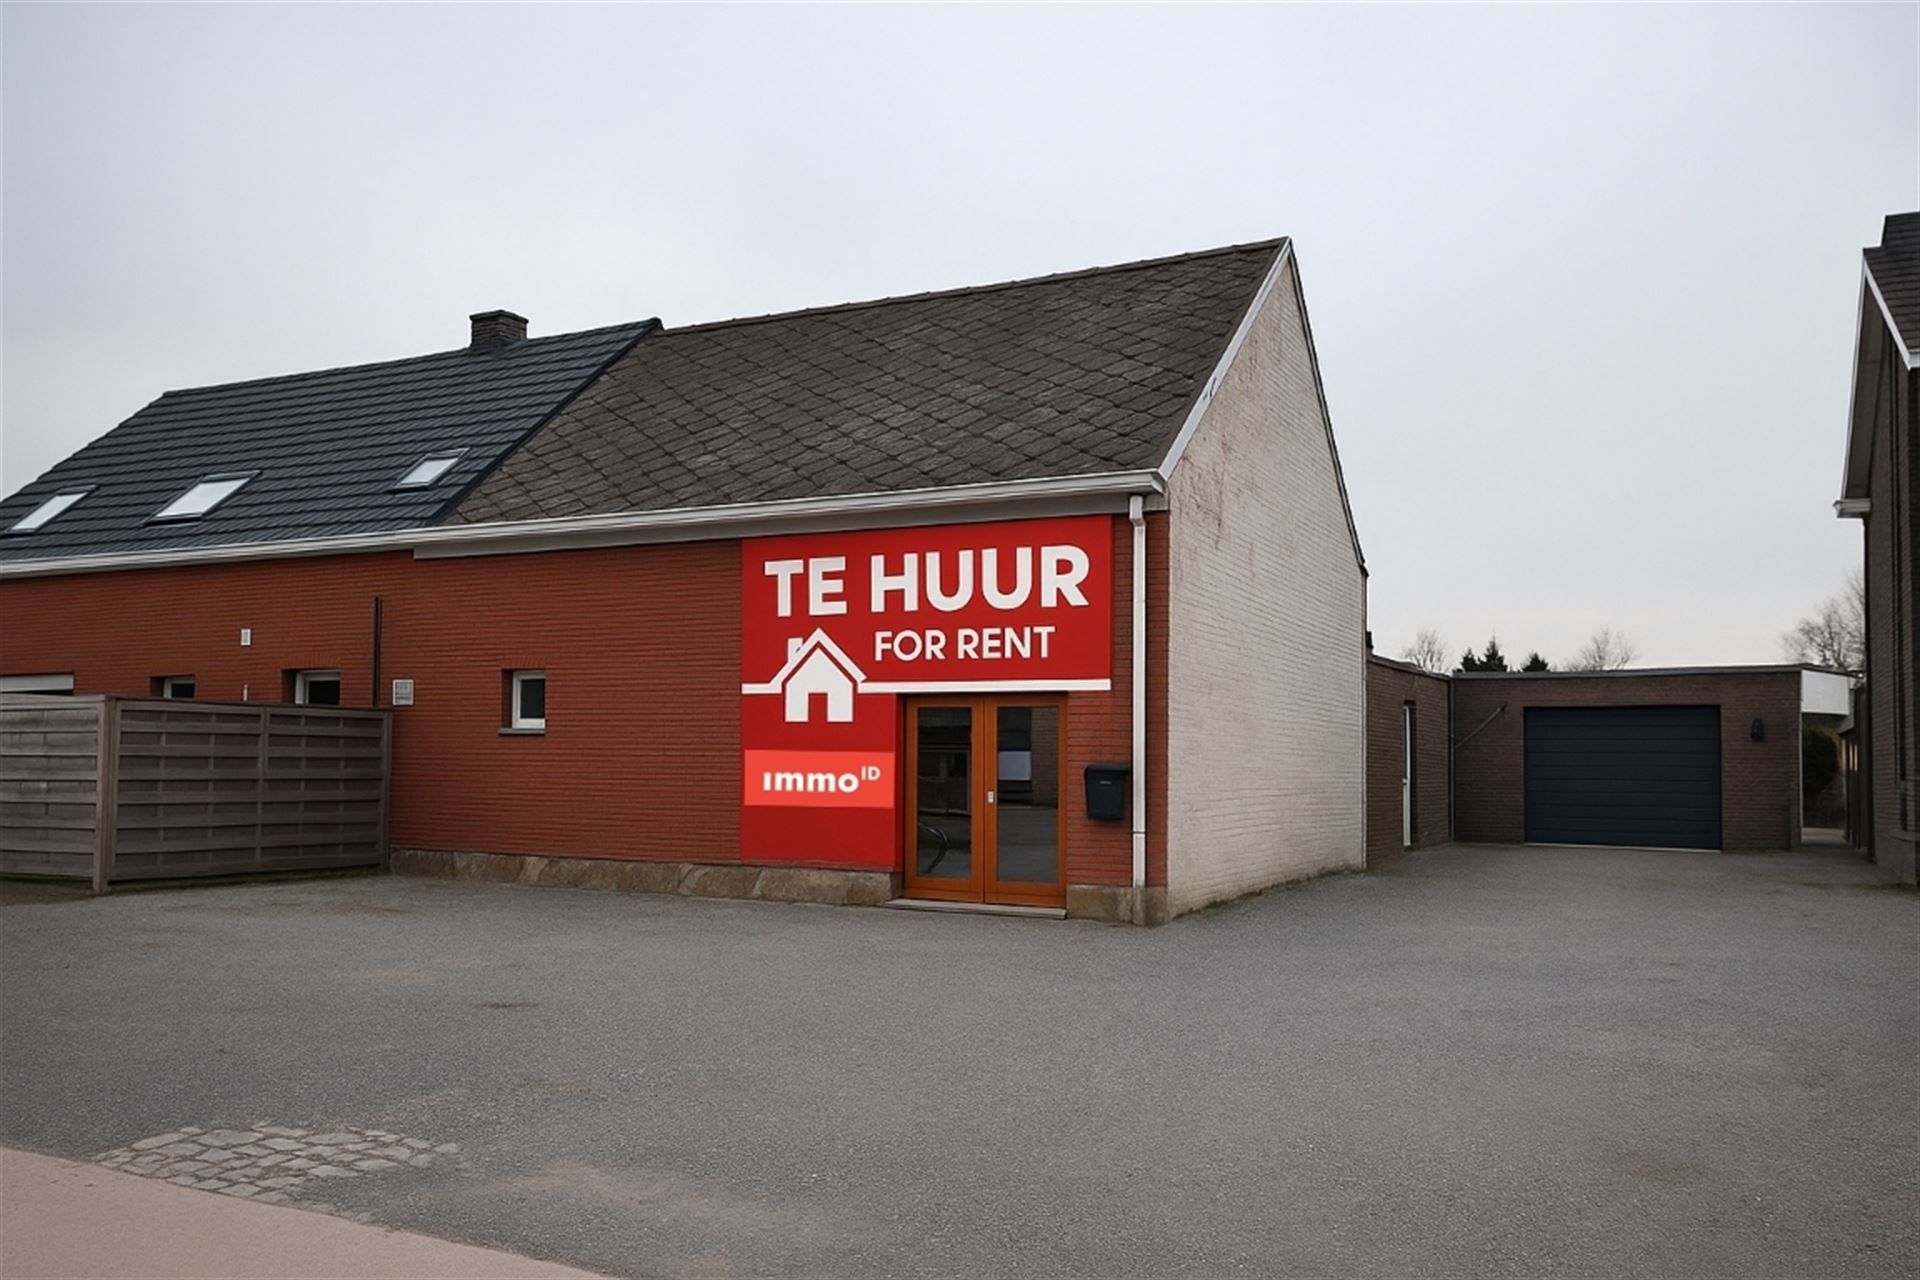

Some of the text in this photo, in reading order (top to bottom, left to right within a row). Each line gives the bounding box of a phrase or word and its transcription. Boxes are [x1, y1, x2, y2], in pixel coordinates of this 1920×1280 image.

[764, 544, 1090, 617] TE HUUR
[874, 625, 1056, 662] FOR RENT
